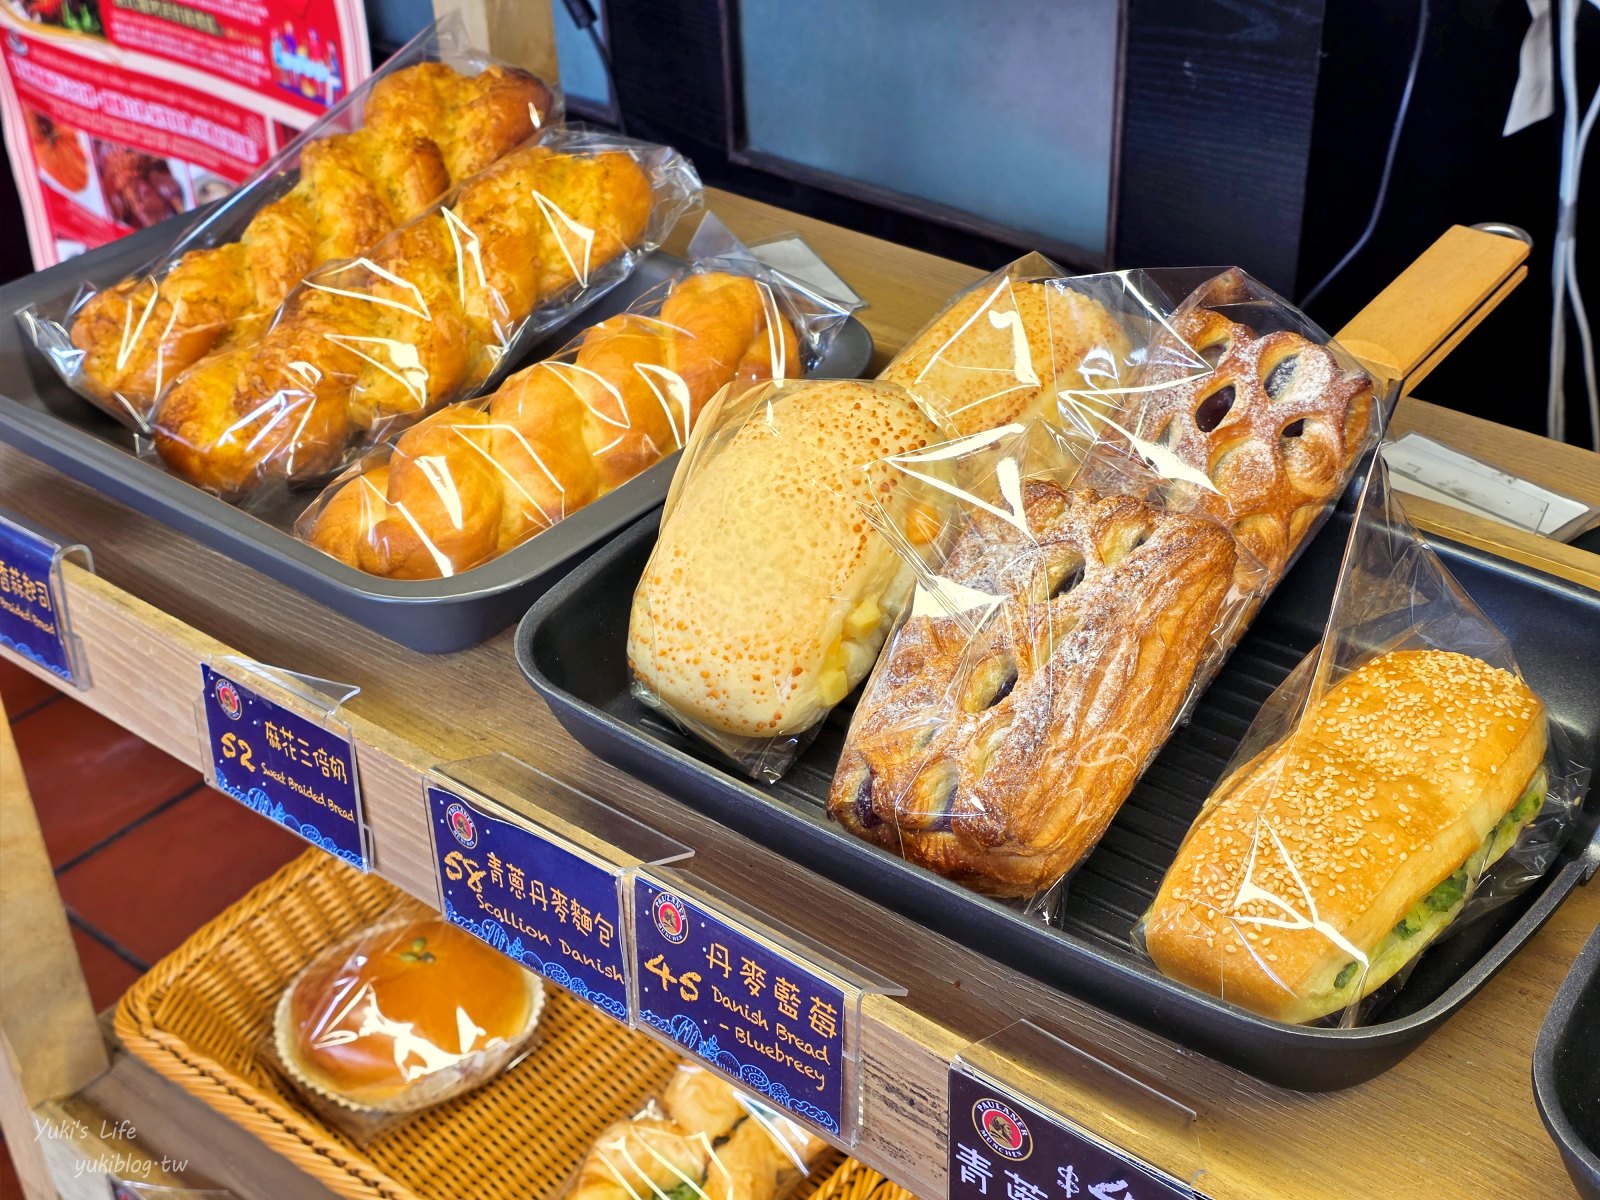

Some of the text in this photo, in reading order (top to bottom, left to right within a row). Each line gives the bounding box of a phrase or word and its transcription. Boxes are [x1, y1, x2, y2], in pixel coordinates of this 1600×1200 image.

[264, 721, 348, 785] 麻花三倍奶
[260, 762, 356, 824] Sweet Braided Bread
[558, 938, 625, 985] Danish
[705, 942, 838, 1039] 丹麥藍莓
[710, 985, 831, 1066] Danish Bread
[977, 1099, 1028, 1136] PAULANER
